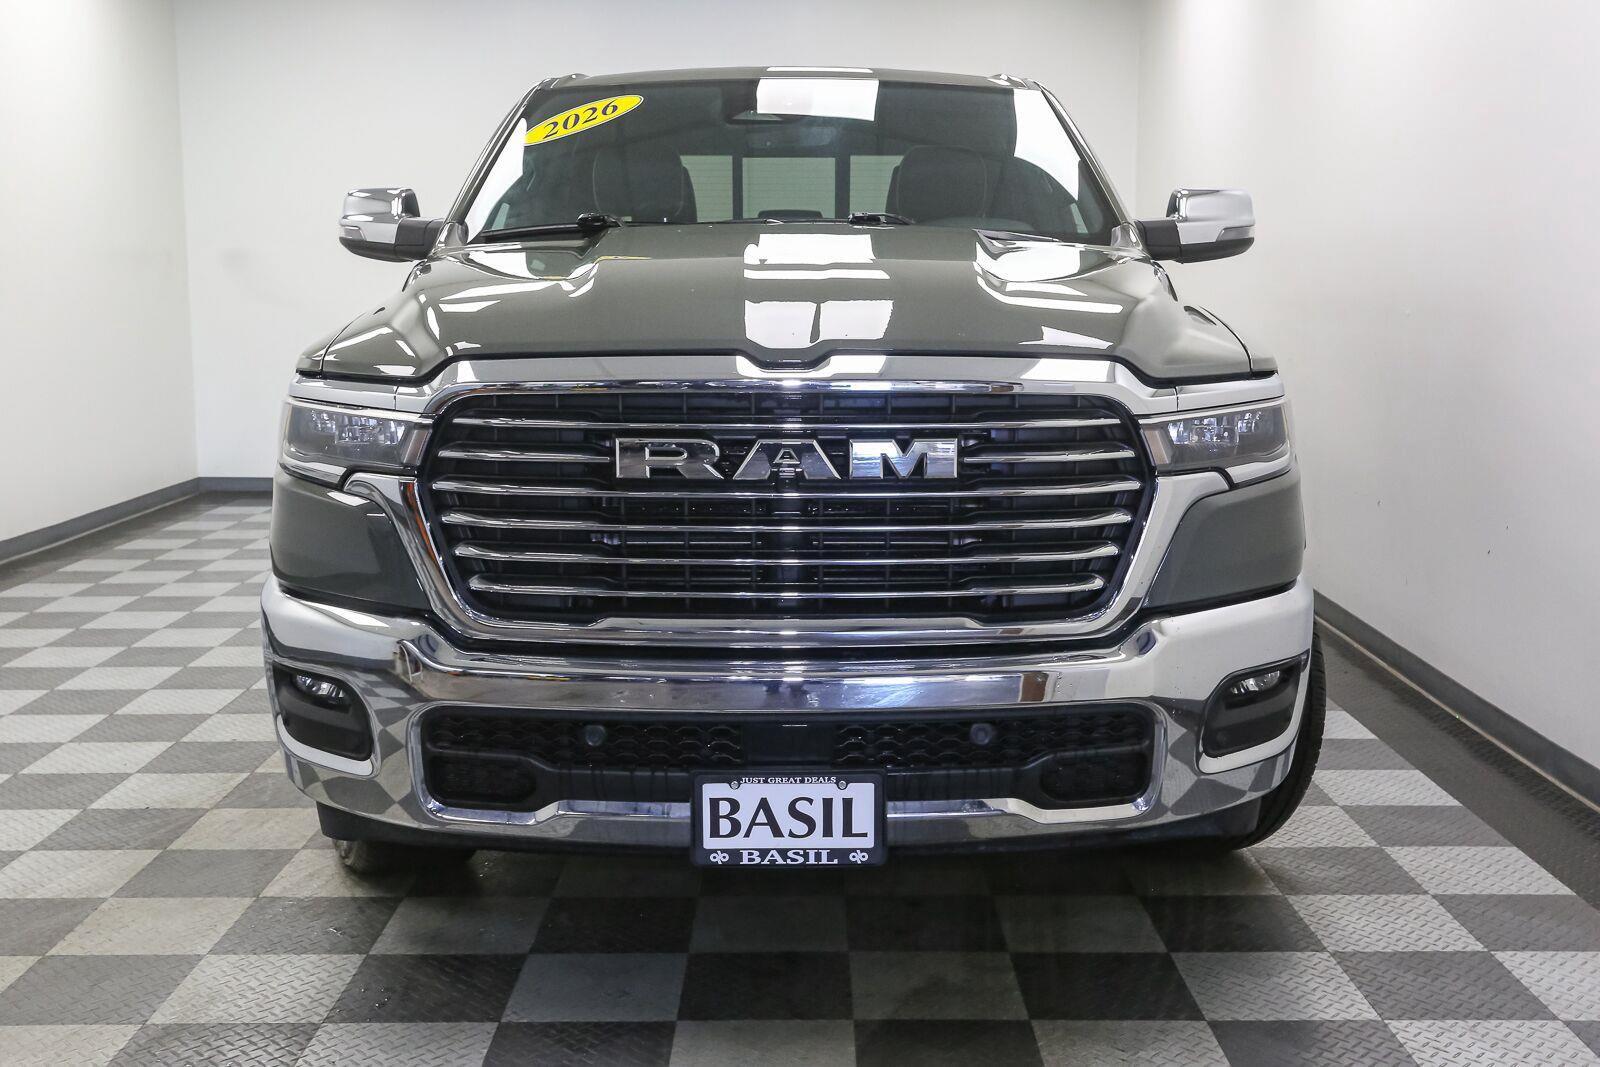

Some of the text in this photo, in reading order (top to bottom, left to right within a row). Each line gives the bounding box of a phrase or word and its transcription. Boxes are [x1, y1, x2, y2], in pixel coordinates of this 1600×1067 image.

[542, 99, 619, 139] 2026
[615, 437, 958, 480] RAM
[740, 776, 837, 784] JUST GREAT DEALS
[708, 796, 868, 839] BASIL
[739, 849, 838, 865] BASIL
